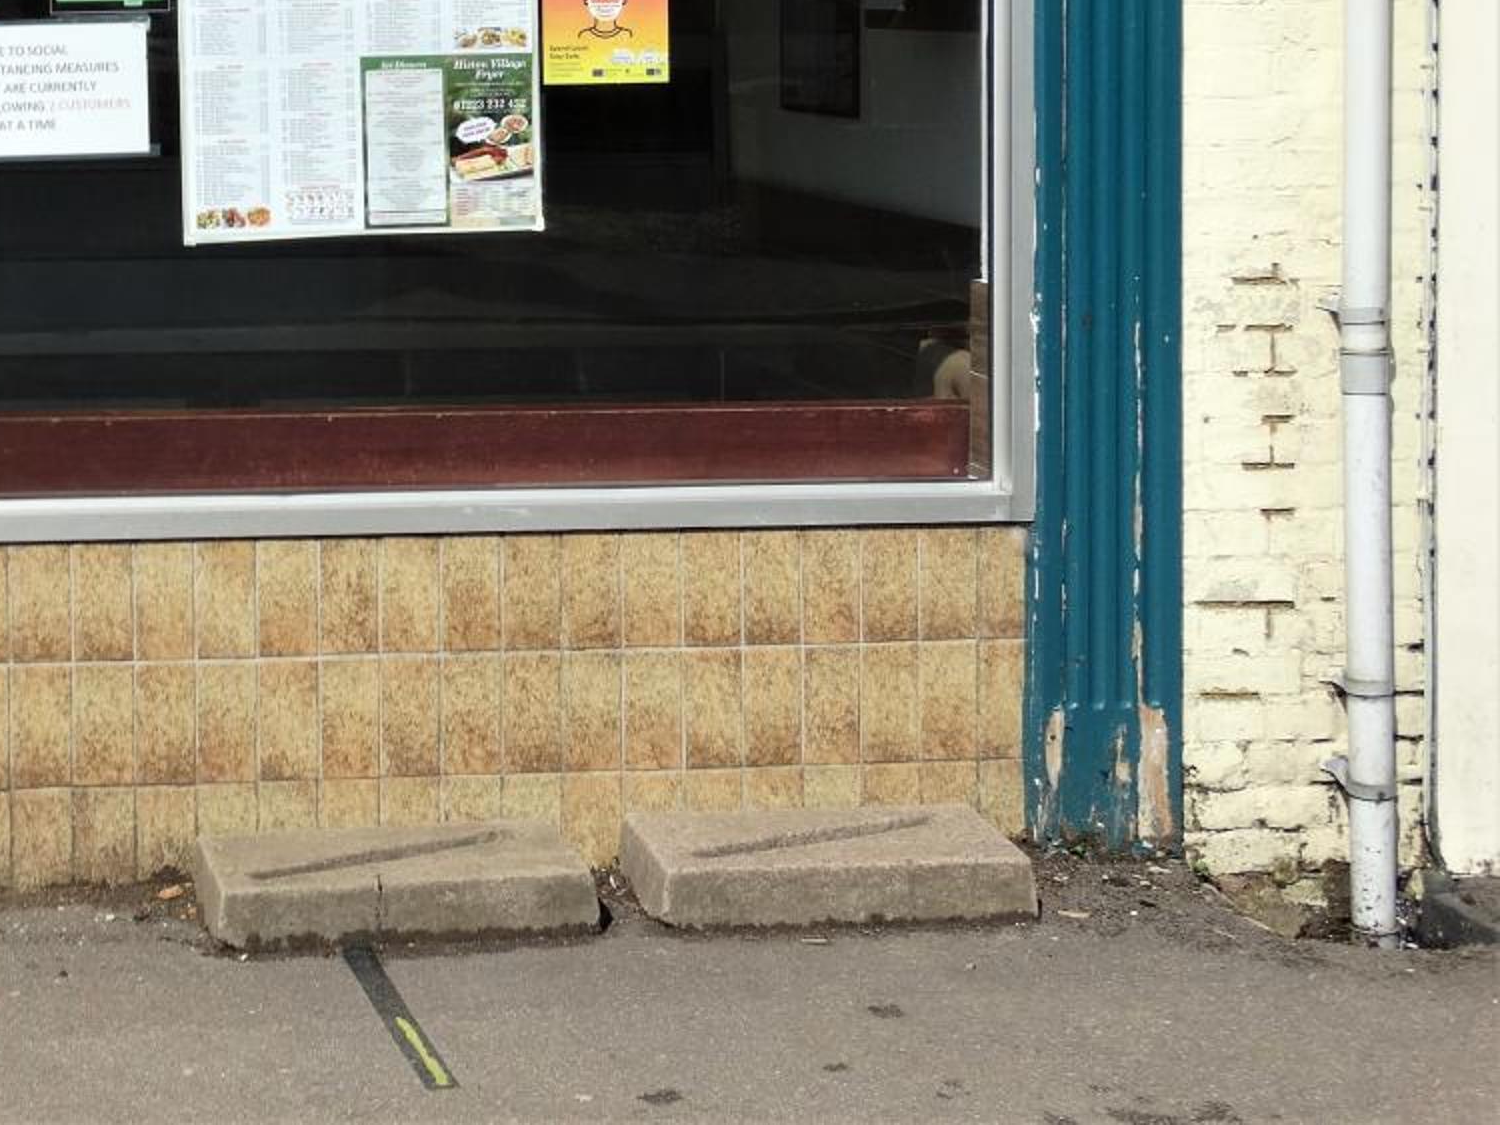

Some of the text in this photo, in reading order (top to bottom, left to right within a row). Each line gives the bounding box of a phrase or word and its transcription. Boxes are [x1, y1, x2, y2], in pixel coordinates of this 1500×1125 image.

[8, 45, 25, 57] TO
[26, 44, 68, 56] SOCIAL
[55, 61, 120, 74] MEASURES
[3, 82, 27, 94] ARE
[29, 80, 97, 93] CURRENTLY
[17, 120, 26, 131] A
[29, 119, 56, 131] TIME
